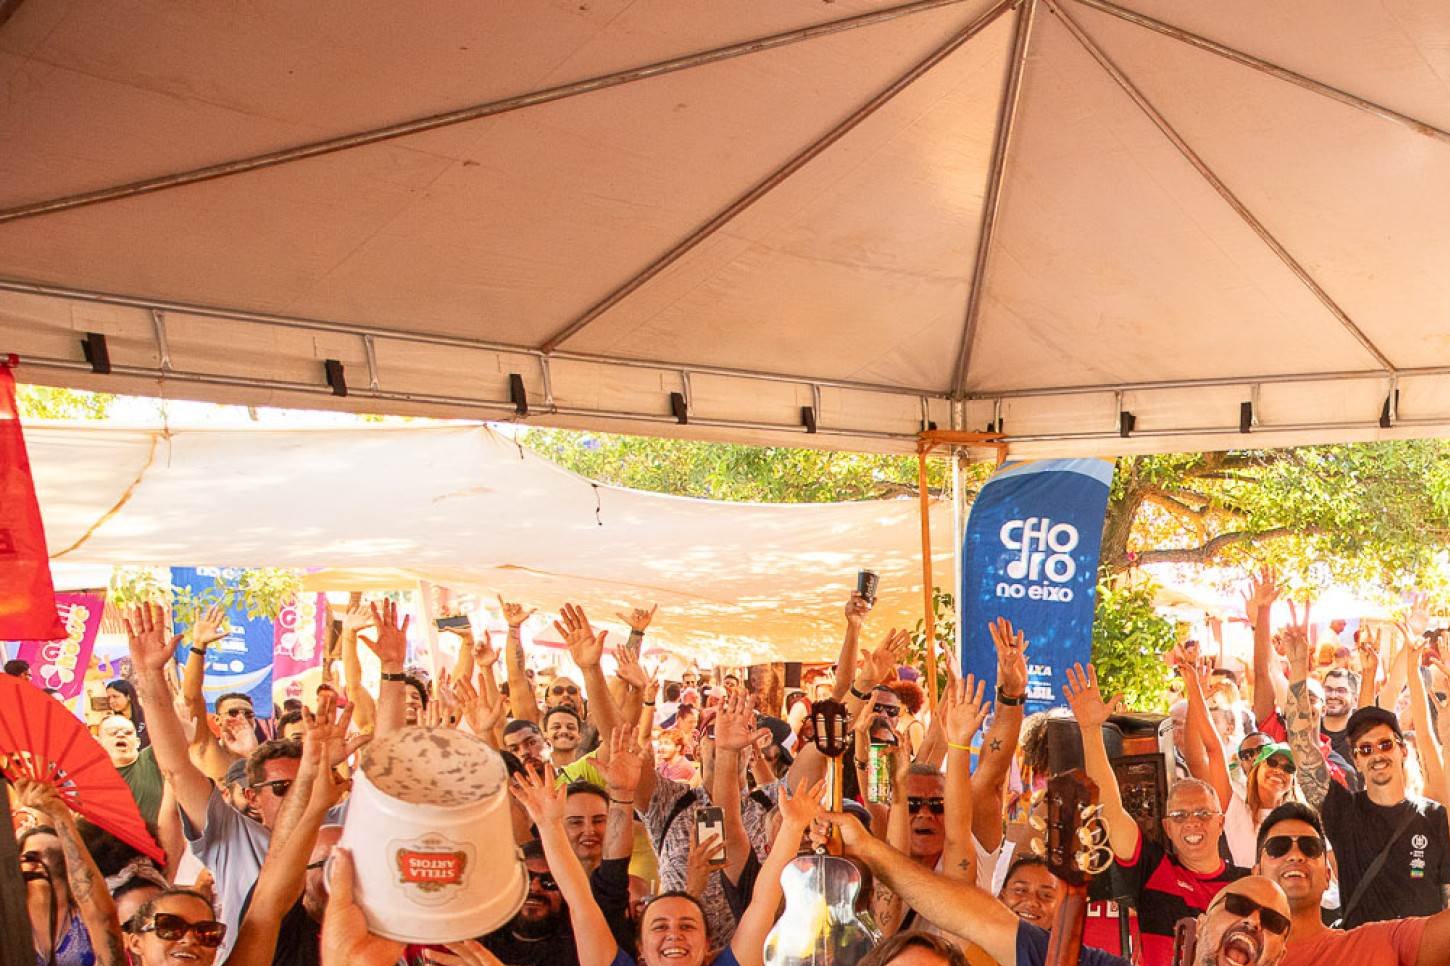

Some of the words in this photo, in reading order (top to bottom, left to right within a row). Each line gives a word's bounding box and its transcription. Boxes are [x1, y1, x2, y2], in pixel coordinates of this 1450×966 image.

[996, 583, 1026, 598] no
[1028, 581, 1074, 602] eixo
[408, 857, 456, 869] ARTOIS
[409, 868, 456, 878] STELLA
